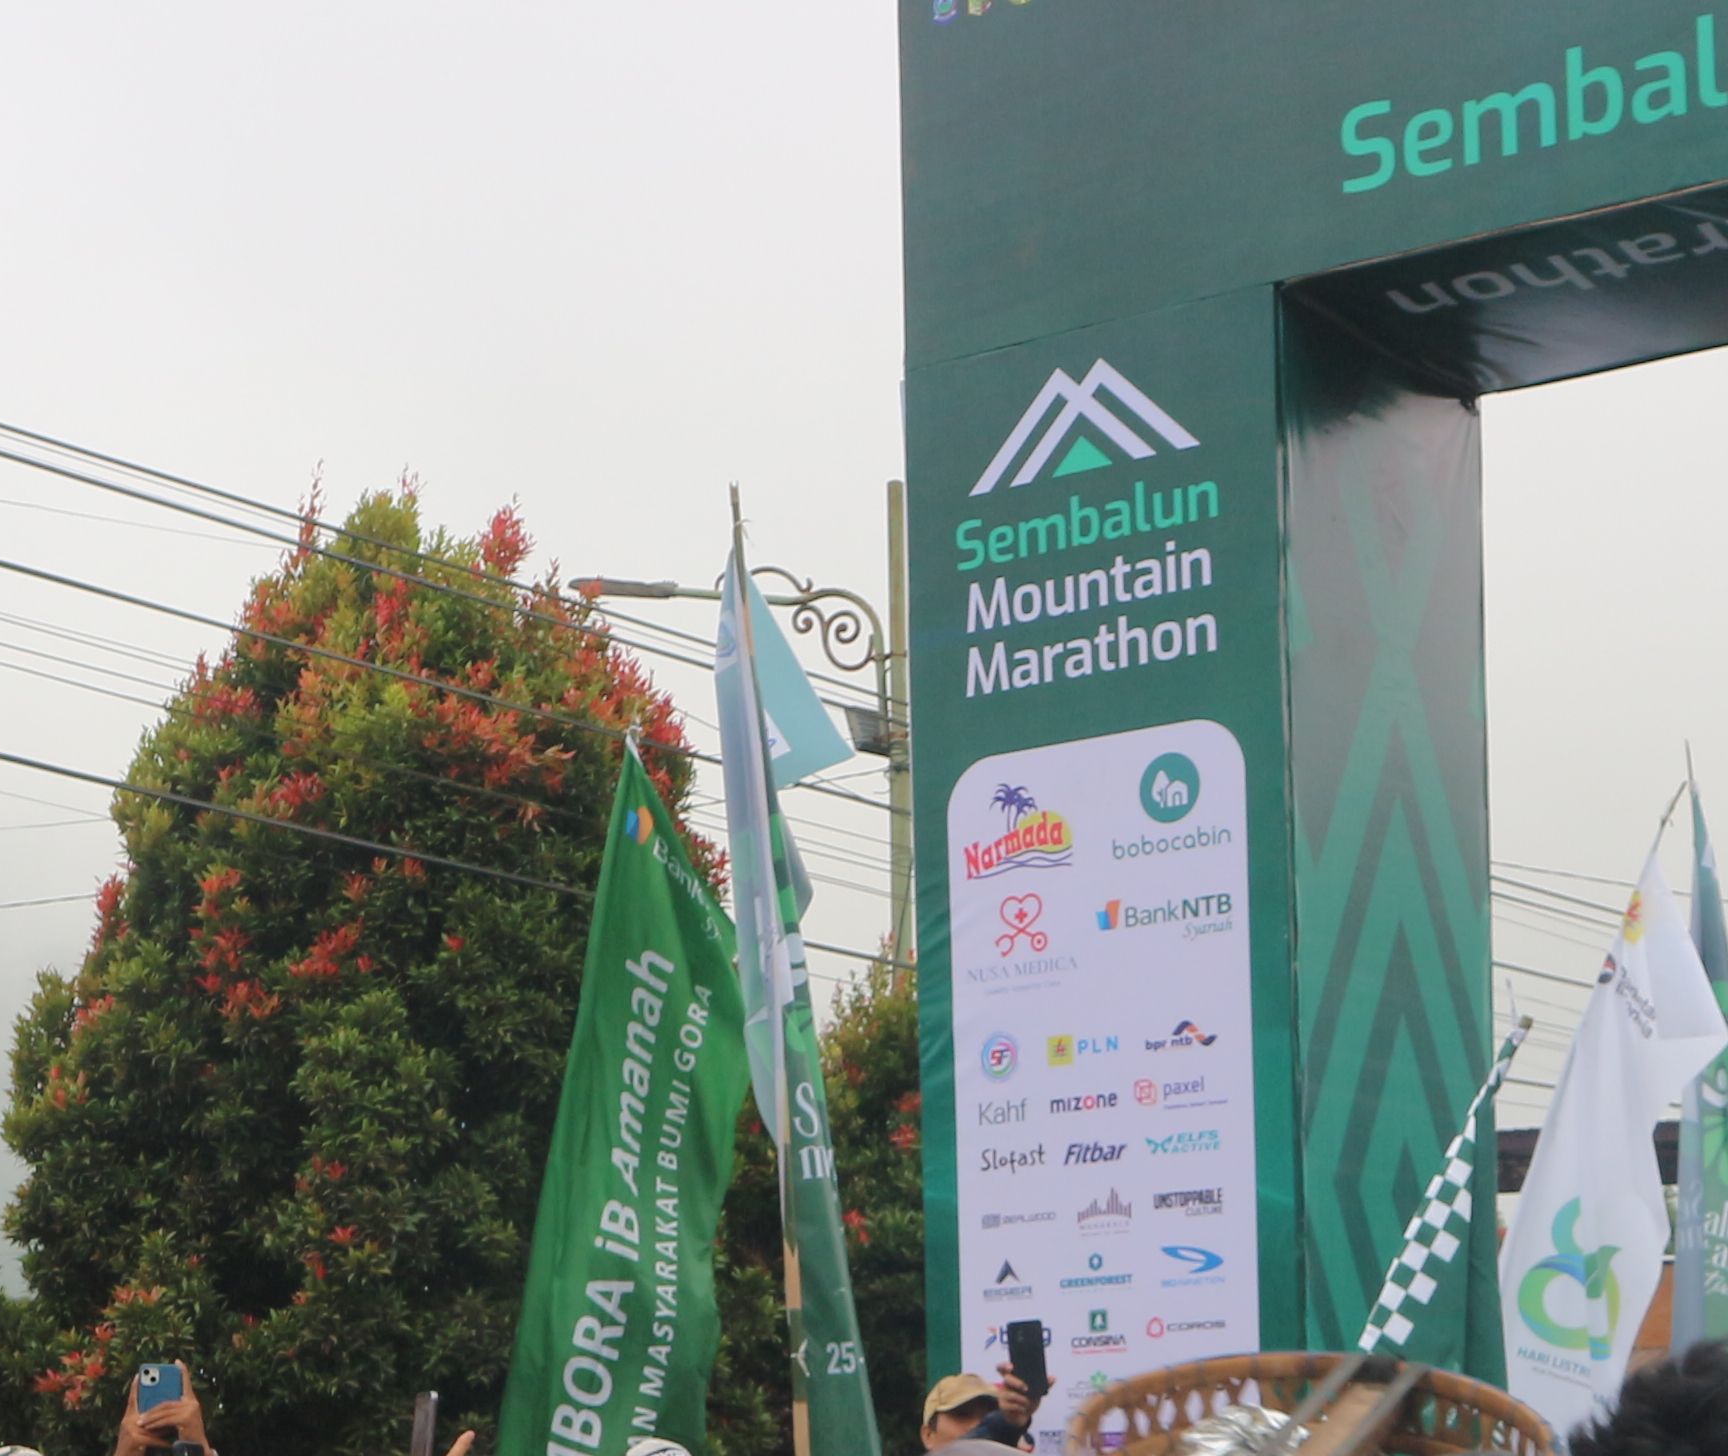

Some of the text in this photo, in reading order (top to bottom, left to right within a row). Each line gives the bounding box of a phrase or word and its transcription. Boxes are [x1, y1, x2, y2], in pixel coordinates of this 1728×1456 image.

[955, 480, 1219, 571] Sembalun
[966, 540, 1214, 634] Mountain
[965, 611, 1218, 698] Marathon
[963, 811, 1064, 881] Narmada
[1112, 826, 1232, 861] bobocabin
[1182, 918, 1233, 942] Syariah
[967, 955, 1078, 984] NUSA MEDICA
[673, 983, 713, 1074] GORA
[1077, 1036, 1120, 1055] PLN
[1144, 1038, 1168, 1052] bpr
[610, 949, 676, 1197] Amanah
[1049, 1089, 1118, 1114] mizone
[1163, 1076, 1205, 1101] paxel
[656, 1079, 692, 1171] BUMI
[978, 1098, 1027, 1127] Kahf
[1171, 1140, 1220, 1153] ACTIVE
[1176, 1129, 1219, 1143] ELFS
[980, 1143, 1046, 1174] Slofast
[1064, 1141, 1127, 1166] Fitbar
[1153, 1187, 1223, 1210] UNSTOPPABLE
[1185, 1205, 1223, 1217] CULTURE
[638, 1175, 680, 1398] MASYARAKAT
[1060, 1273, 1133, 1289] GREENFOREST
[1071, 1334, 1127, 1349] CONSINA
